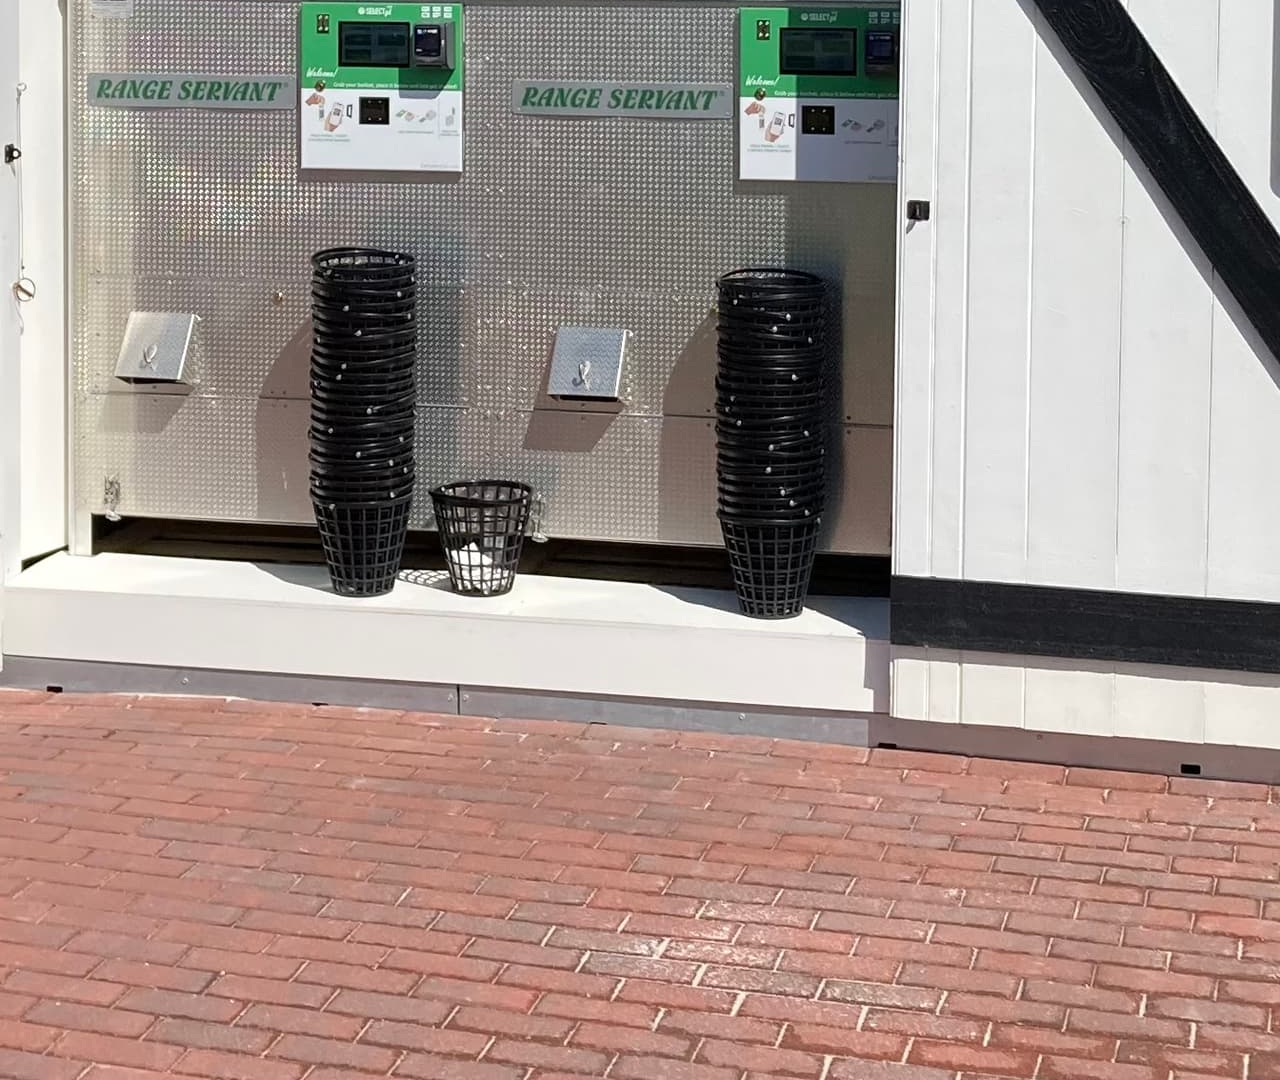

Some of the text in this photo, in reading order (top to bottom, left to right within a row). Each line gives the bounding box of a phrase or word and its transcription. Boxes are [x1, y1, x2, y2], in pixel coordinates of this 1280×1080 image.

[96, 78, 283, 102] RANGE SERVANT
[521, 87, 719, 111] RANGE SERVANT
